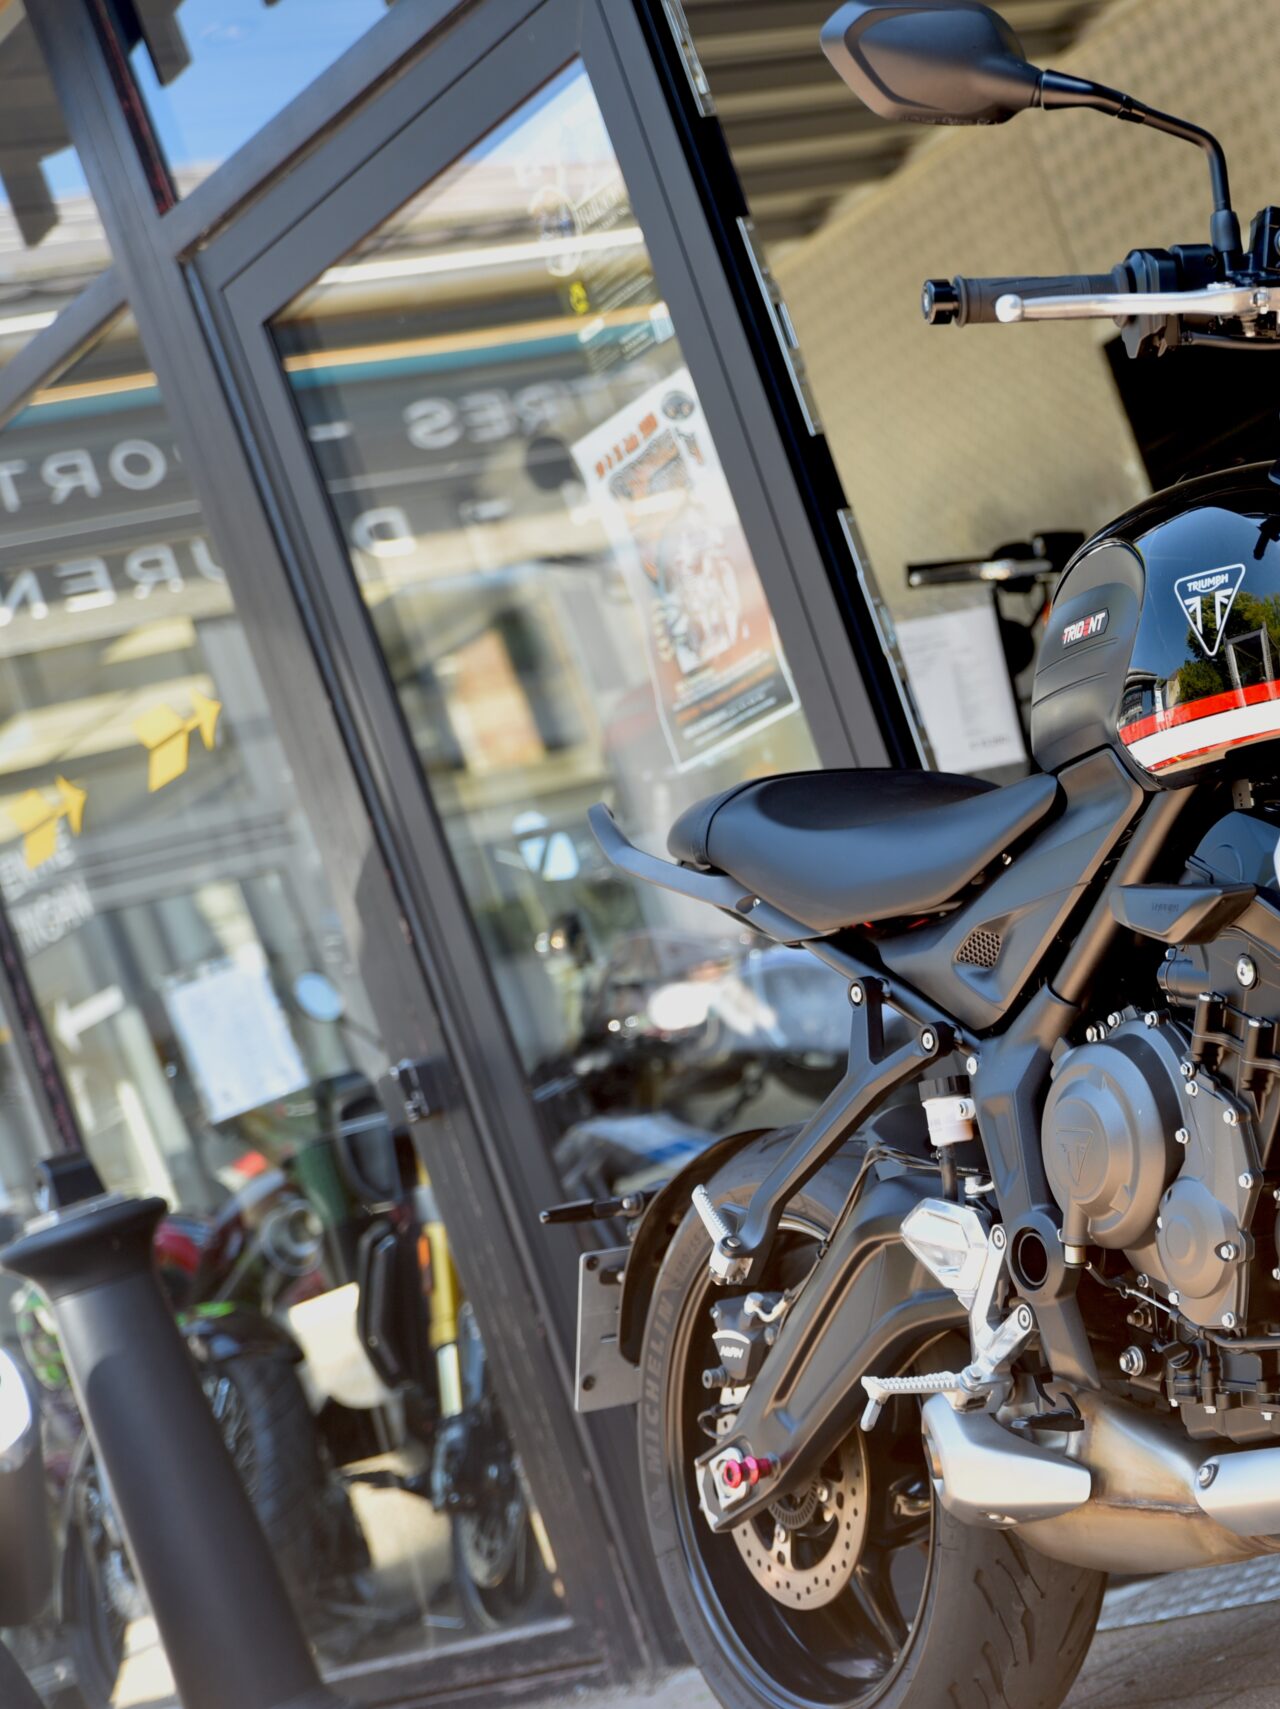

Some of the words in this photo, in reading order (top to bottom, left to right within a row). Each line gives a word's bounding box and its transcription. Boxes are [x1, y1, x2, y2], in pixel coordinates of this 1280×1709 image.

[1187, 573, 1229, 592] TRIUMPH
[1063, 612, 1106, 645] TRIDENT
[645, 1294, 674, 1474] MICHELIN
